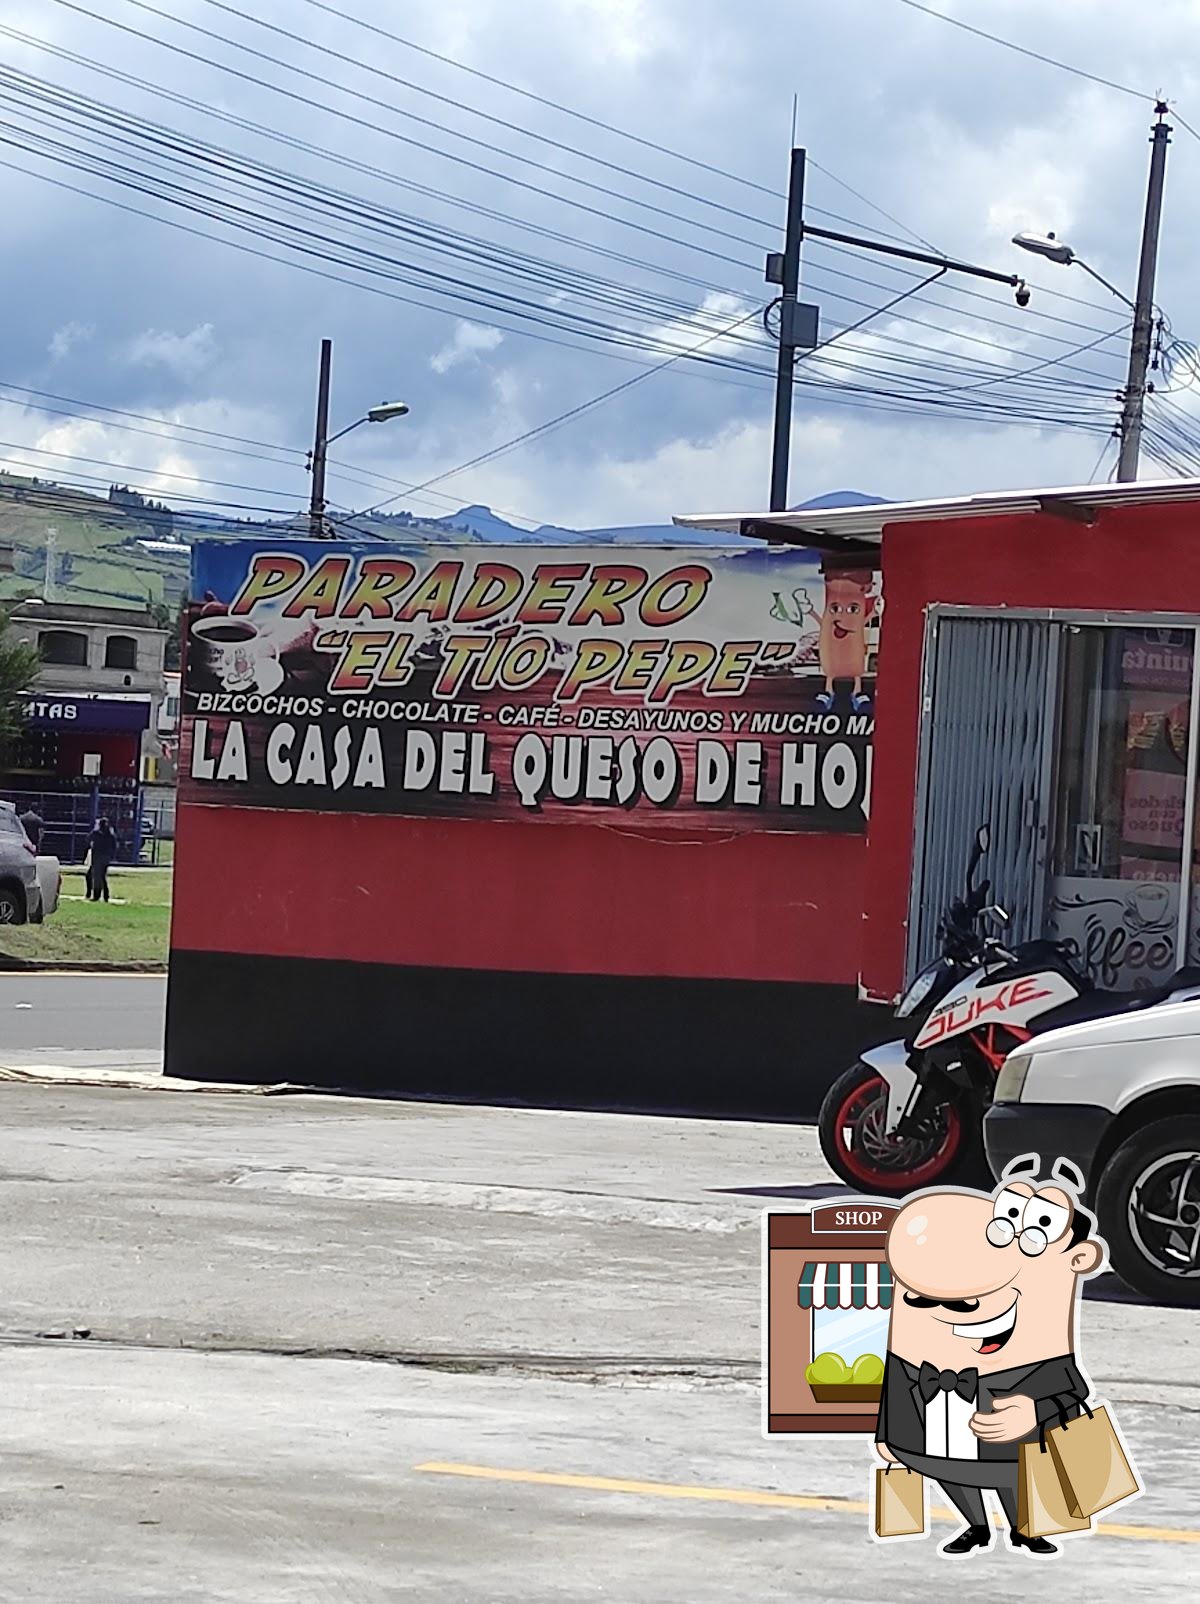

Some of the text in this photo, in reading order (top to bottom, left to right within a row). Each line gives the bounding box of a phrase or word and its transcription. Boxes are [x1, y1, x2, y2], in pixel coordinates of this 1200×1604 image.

[229, 556, 713, 628] PARADERO
[436, 625, 551, 696] TÍO
[197, 693, 324, 716] BIZCOCHOS
[342, 701, 479, 723] CHOCOLATE
[498, 703, 559, 728] CAFÉ
[577, 708, 723, 732] DESAYUNOS
[731, 712, 747, 732] Y
[750, 713, 840, 734] MUCHO
[191, 719, 249, 781] LA
[266, 722, 386, 790] CASA
[403, 729, 494, 794] DEL
[512, 732, 677, 806] QUESO
[696, 739, 762, 804] DE
[916, 978, 1053, 1047] DUKE
